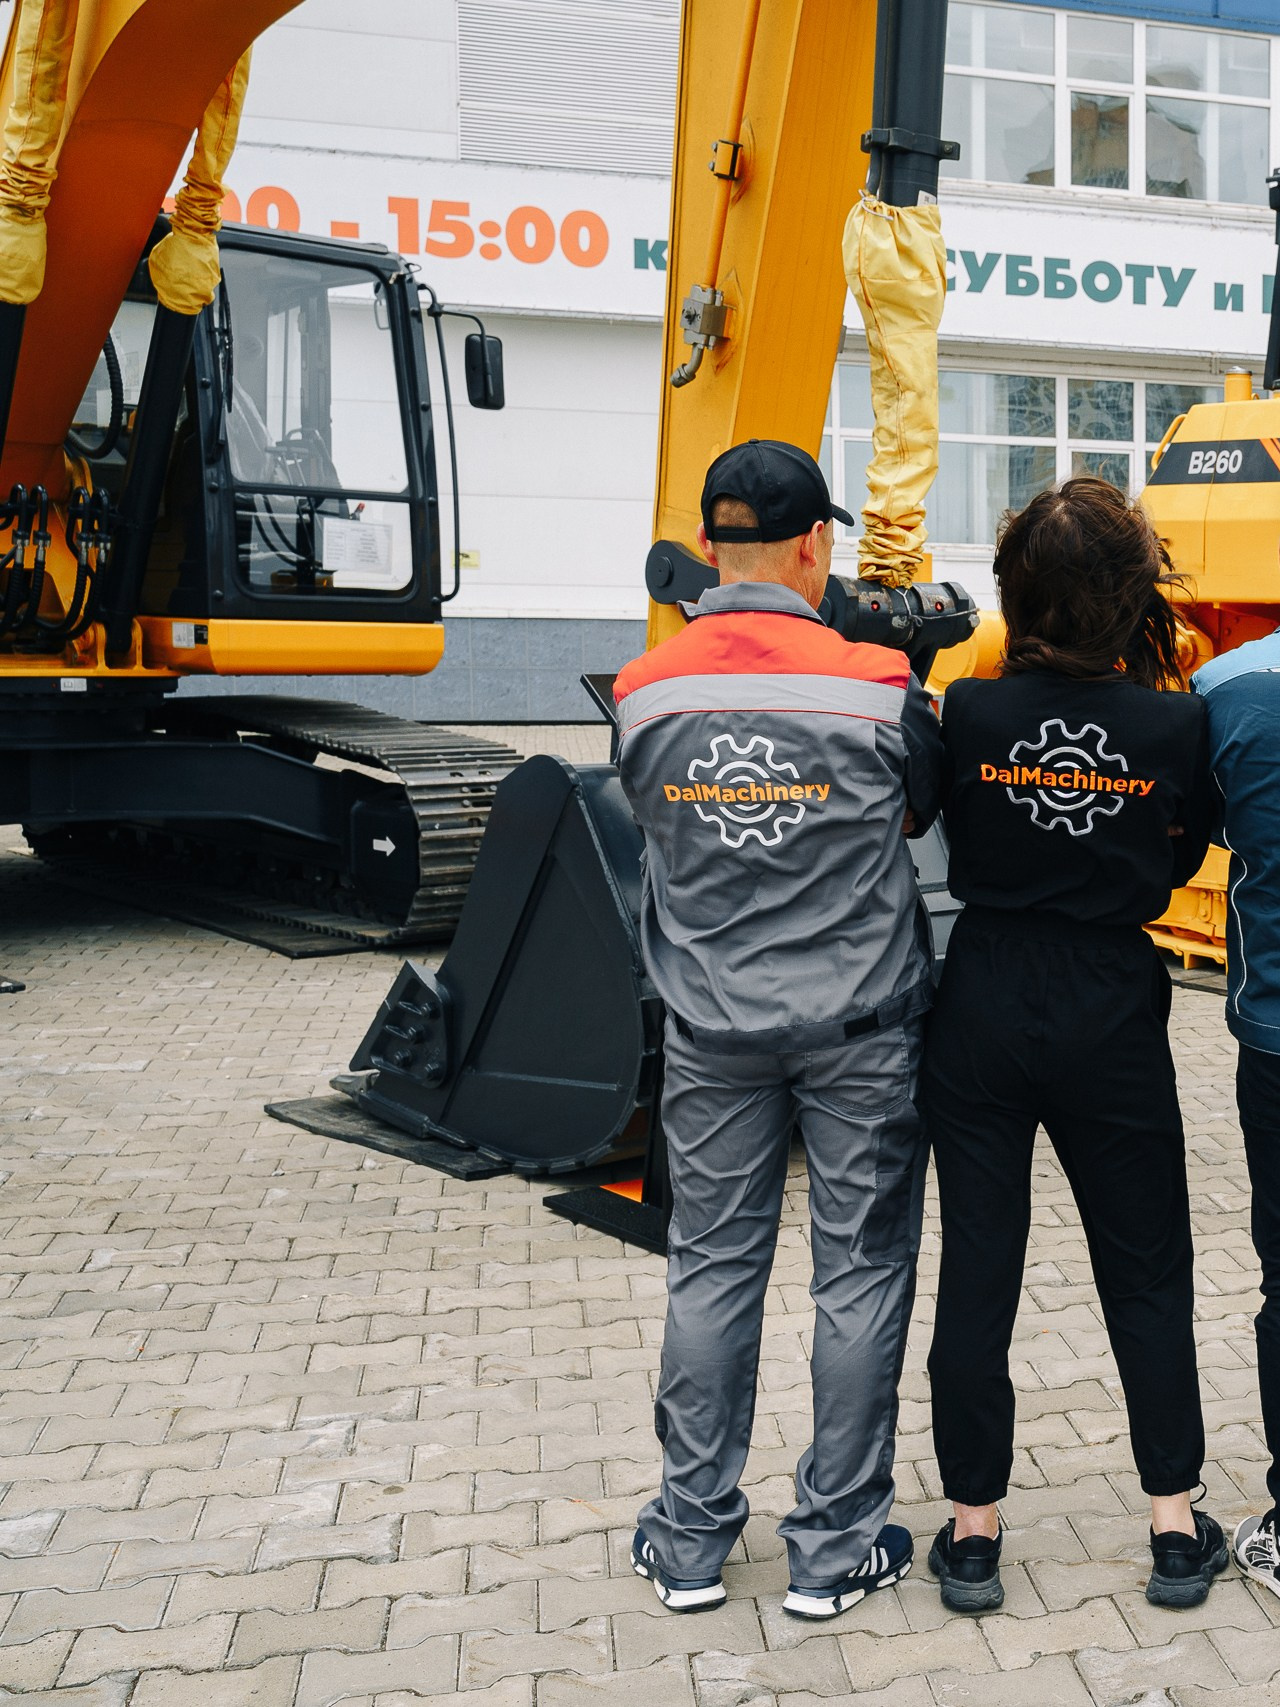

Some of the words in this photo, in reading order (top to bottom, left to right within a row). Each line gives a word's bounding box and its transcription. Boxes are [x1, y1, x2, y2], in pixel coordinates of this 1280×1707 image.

[387, 195, 610, 268] 15:00
[944, 247, 1198, 308] УББОТУ
[1213, 282, 1245, 313] и
[1187, 449, 1243, 475] B260
[663, 781, 831, 803] DalMachinery
[980, 763, 1156, 797] DalMachinery
